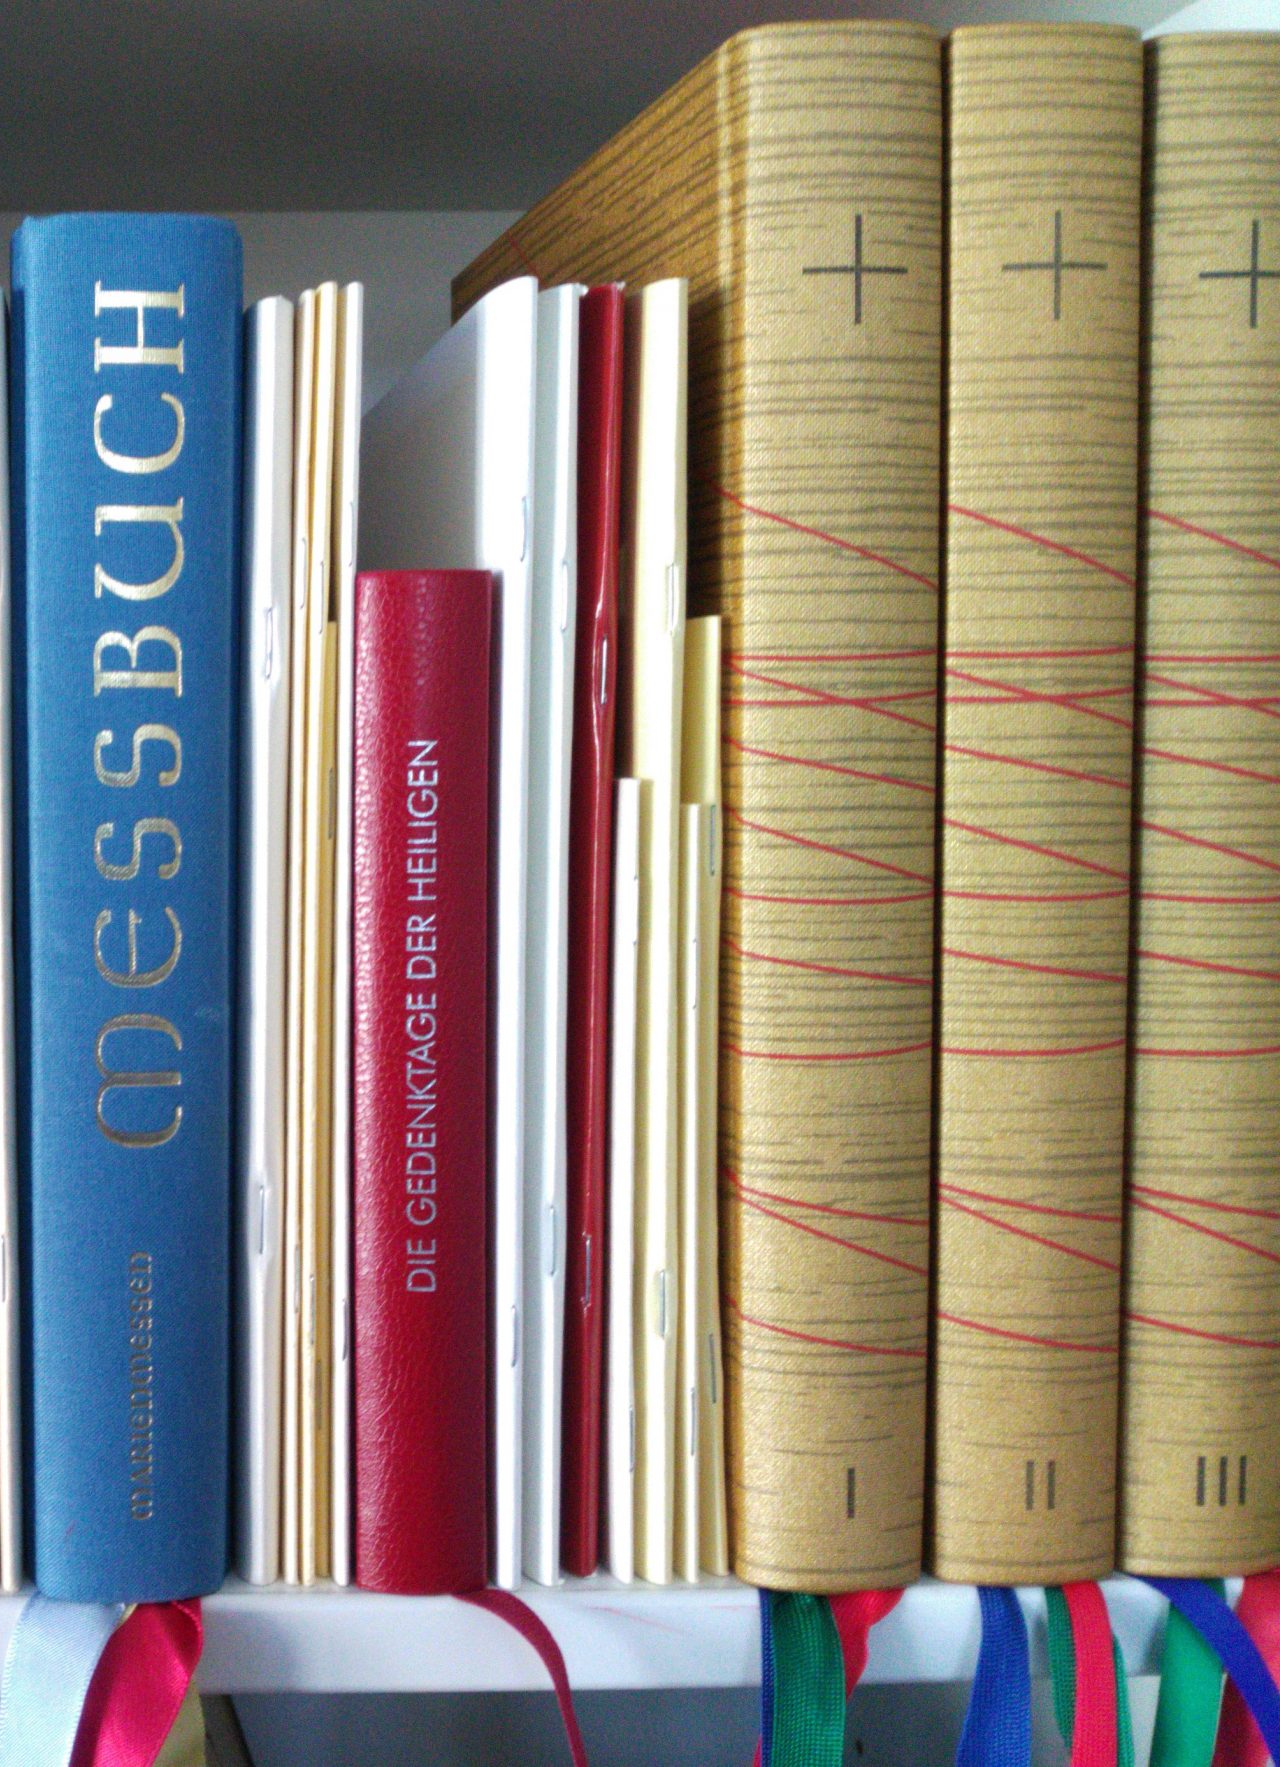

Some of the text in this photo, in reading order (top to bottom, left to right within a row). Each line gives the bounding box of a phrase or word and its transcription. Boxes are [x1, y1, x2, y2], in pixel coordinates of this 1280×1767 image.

[93, 280, 186, 1149] MESSBUCH
[405, 739, 439, 1293] DIE GEDENKTAGE DER HEILIGEN
[1195, 1456, 1248, 1507] III
